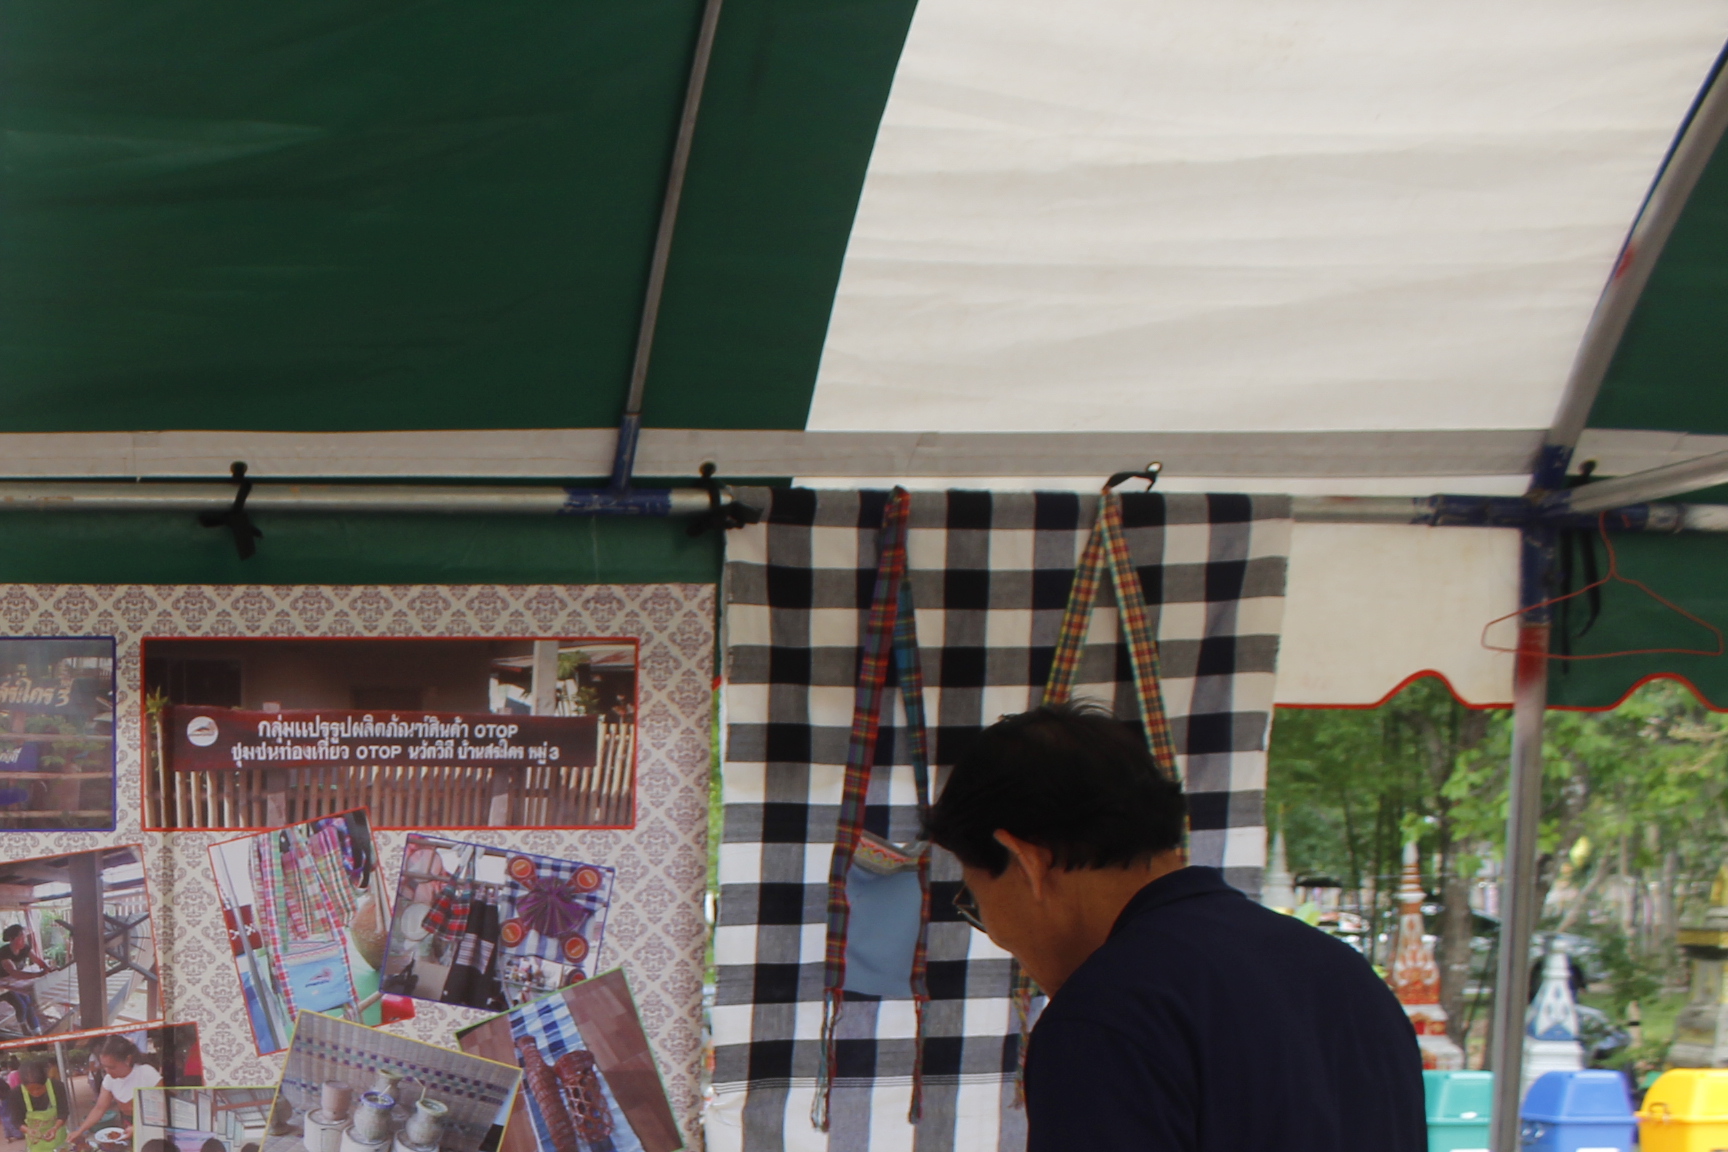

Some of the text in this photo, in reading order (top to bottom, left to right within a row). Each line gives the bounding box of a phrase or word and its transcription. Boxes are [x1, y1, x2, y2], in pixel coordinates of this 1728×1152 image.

[258, 714, 519, 744] กลุ่มแปรรูปผลิตภัณฑ์สินค้า OTOP
[231, 738, 560, 768] ชุมชนท่องเที่ยว OTOP นวัตวิถี บ้านสระใคร หมู่ 3
